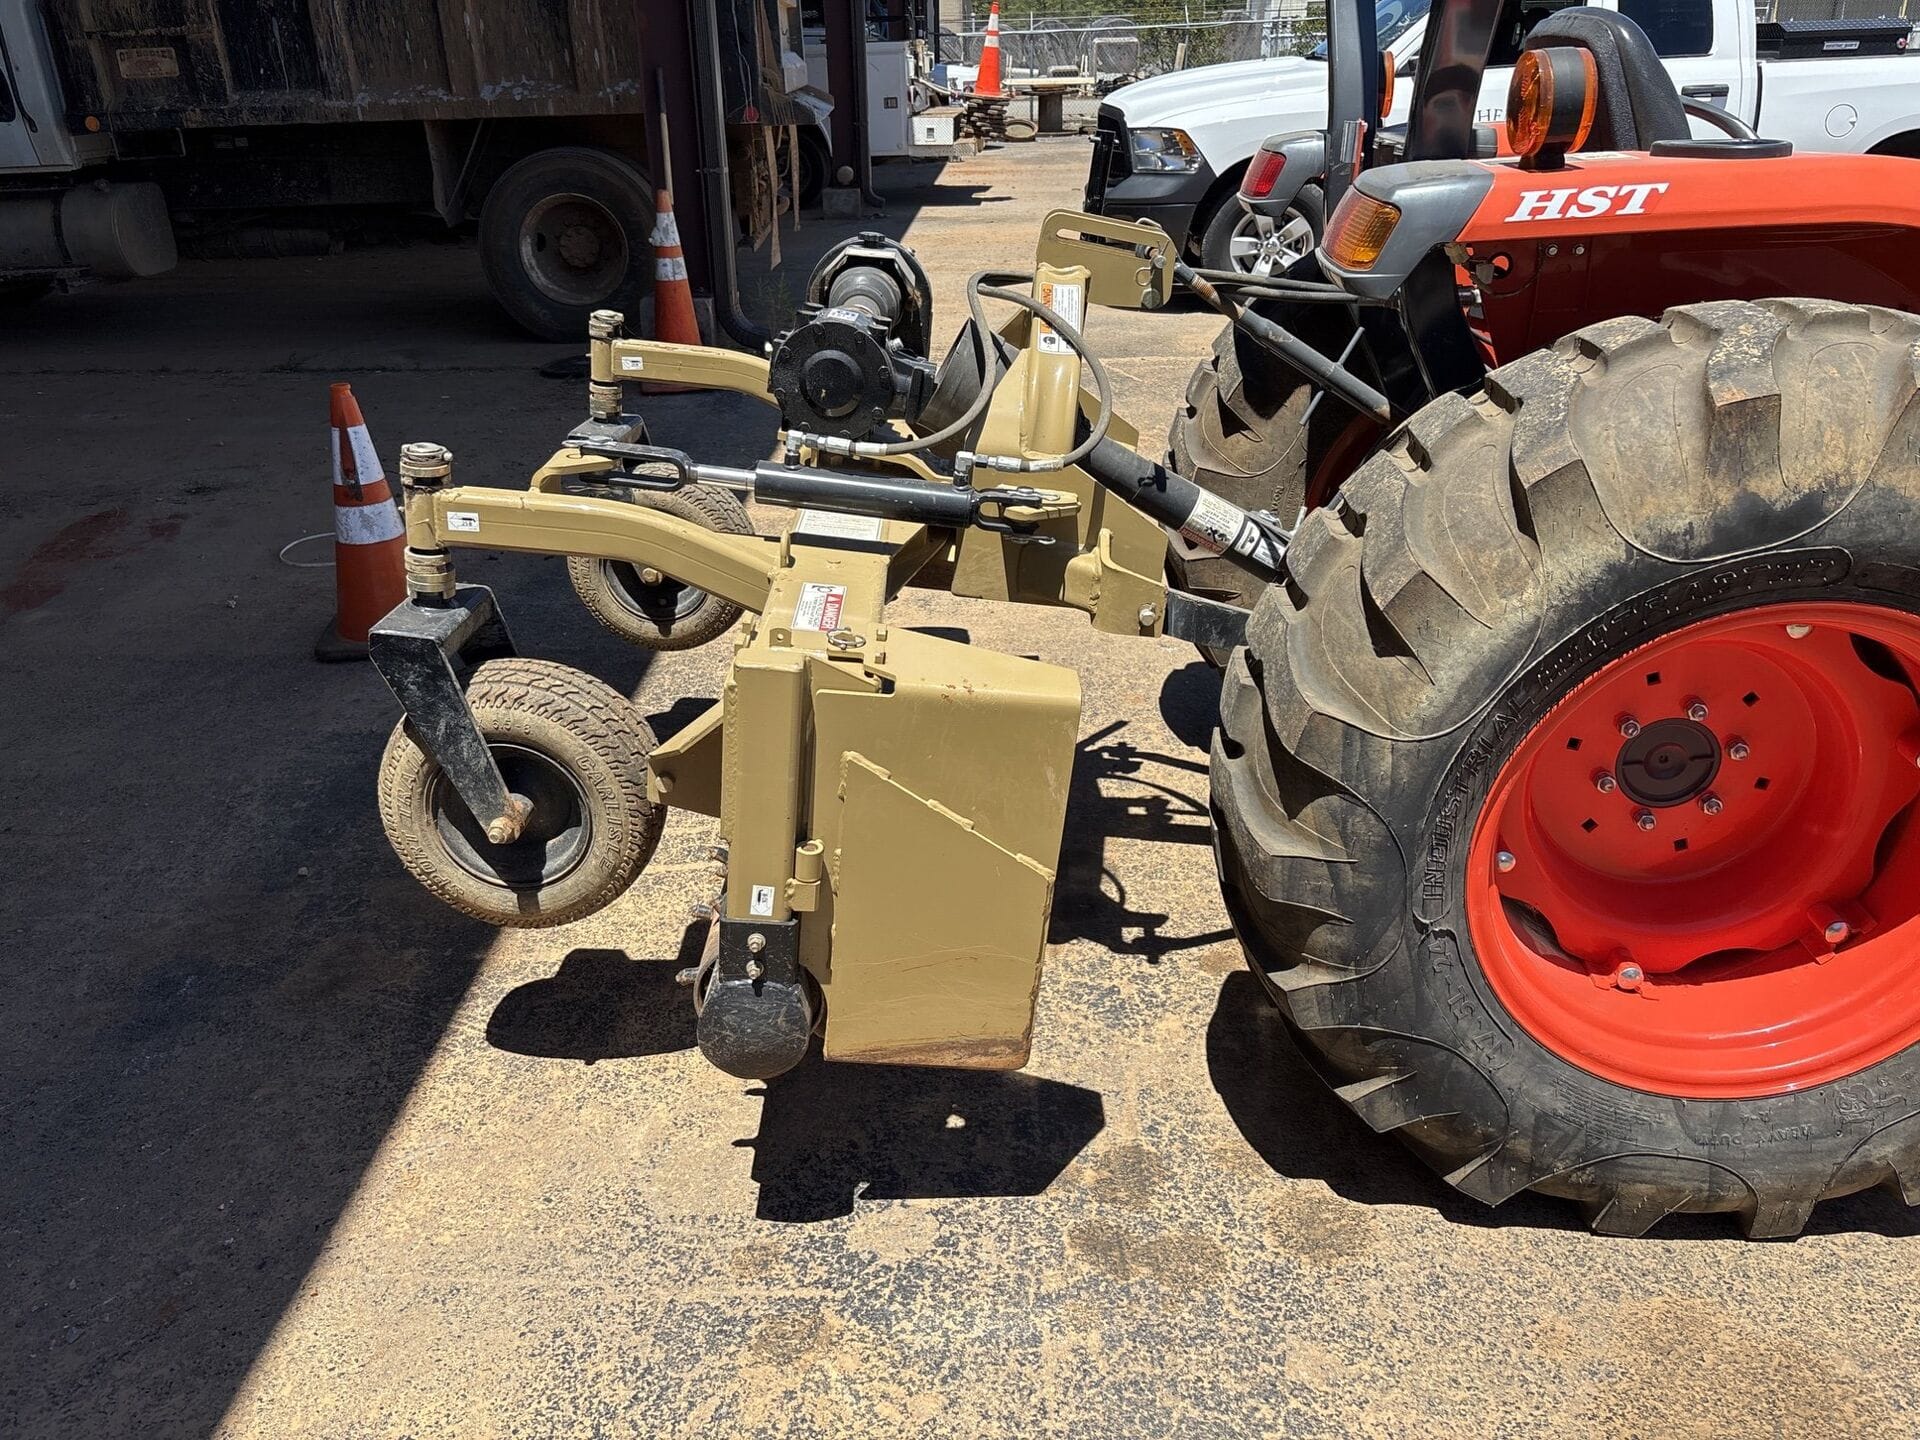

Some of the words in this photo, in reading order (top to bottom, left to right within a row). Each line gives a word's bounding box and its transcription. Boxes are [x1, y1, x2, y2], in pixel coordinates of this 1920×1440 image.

[1503, 182, 1670, 223] HST
[821, 603, 841, 629] DANGER
[575, 755, 624, 870] CARLISLE
[404, 829, 465, 899] SPORT
